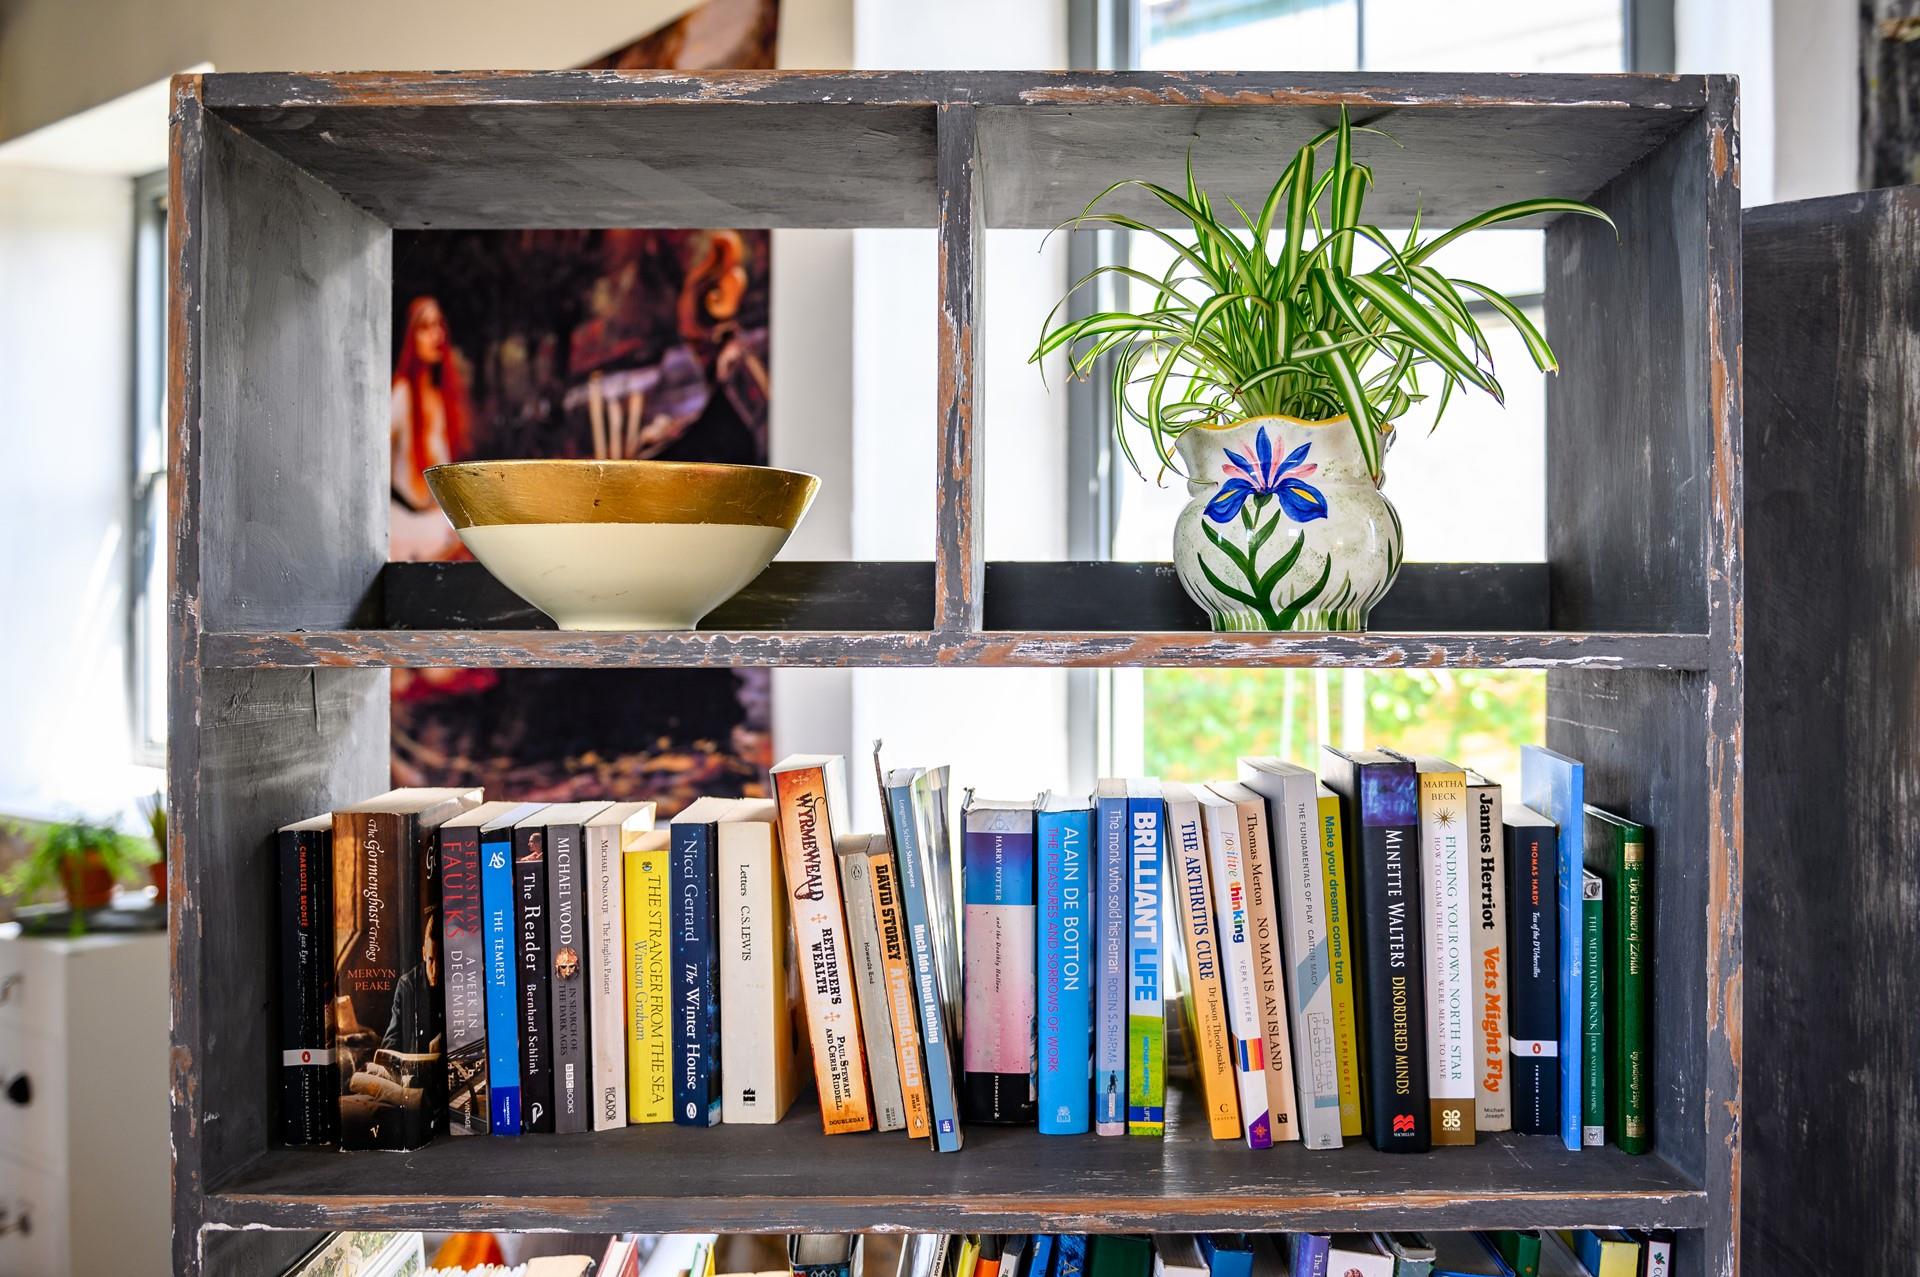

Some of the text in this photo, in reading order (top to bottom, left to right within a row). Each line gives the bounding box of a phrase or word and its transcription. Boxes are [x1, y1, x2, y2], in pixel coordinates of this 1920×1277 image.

[1424, 780, 1463, 788] MARTHA
[740, 864, 750, 896] Letters
[794, 791, 825, 901] WYRMEWEALD
[902, 829, 912, 849] School
[905, 850, 916, 888] Shakespeare
[995, 836, 1003, 864] HARRY
[1433, 837, 1441, 861] HOW
[1434, 863, 1442, 876] TO
[363, 820, 385, 962] The Gormenghast Trilogy
[443, 841, 465, 939] FAULKS
[464, 841, 479, 938] SEBASTIAN
[557, 837, 574, 944] MICHAEL WOOD
[601, 839, 612, 994] MICHAEL ONDAATJE The English Patient
[875, 865, 902, 961] DAVID STOREY
[1064, 827, 1079, 990] ALAIN DE BOTTON
[1108, 810, 1121, 973] The monk who sold his Ferrari
[1134, 812, 1157, 1001] BRILLIANT LIFE
[1181, 821, 1215, 980] THE ARTHRITIS CURE
[1221, 832, 1246, 943] positive thinking
[1298, 803, 1318, 986] THE FUNDAMENTALS OF PLAY CAITLIN MACY
[1325, 816, 1345, 984] Make your dreams come true
[1434, 880, 1442, 907] CLAIM
[1435, 912, 1443, 929] THE
[1627, 877, 1641, 975] The Prisoner of Zenda
[348, 968, 396, 979] MERVYN
[494, 910, 506, 986] THE TEMPEST
[524, 873, 541, 1075] The Reader Bernhard Schlink
[683, 840, 701, 1089] Nicci Gerrard The Winter House
[811, 940, 828, 994] WEALTH
[822, 927, 842, 1004] RETURNER'S
[914, 924, 940, 1044] Much Ado About Nothing
[1047, 827, 1058, 1072] THE PLEASURES AND SORROWS OF WORK
[1246, 814, 1283, 1071] Thomas Merton NO MAN IS AN ISLAND
[1386, 830, 1410, 1094] MINETTE WALTERS DISORDERED MINDS
[1445, 836, 1462, 1080] FINDING YOUR OWN NORTH STAR
[1480, 793, 1503, 1093] James Herriot Vets Might Fly
[1589, 916, 1599, 1030] THE MEDITATION BOOK
[355, 981, 391, 991] PEAKE
[450, 950, 467, 1040] DECEMBER
[467, 972, 478, 1006] WEEK
[468, 1014, 479, 1029] IN
[559, 984, 569, 1055] THE DARK AGES
[569, 987, 578, 1051] IN SEARCH OF
[635, 939, 650, 1040] Winston Graham
[648, 876, 665, 1104] THE STRANGER FROM THE SEA
[1208, 987, 1217, 997] Dr
[1208, 999, 1220, 1021] Jason
[1240, 960, 1252, 1023] VERA PEIFFER
[1437, 980, 1445, 1005] WERE
[1438, 1008, 1446, 1039] MEANT
[826, 1028, 842, 1110] AND CHRIS RIDDELL
[837, 1036, 851, 1098] PAUL STEWART
[1338, 1002, 1351, 1096] ULLI SPRINGETT
[1439, 1043, 1446, 1055] TO
[1439, 1060, 1447, 1080] LIVE
[606, 1087, 616, 1121] PICADOR
